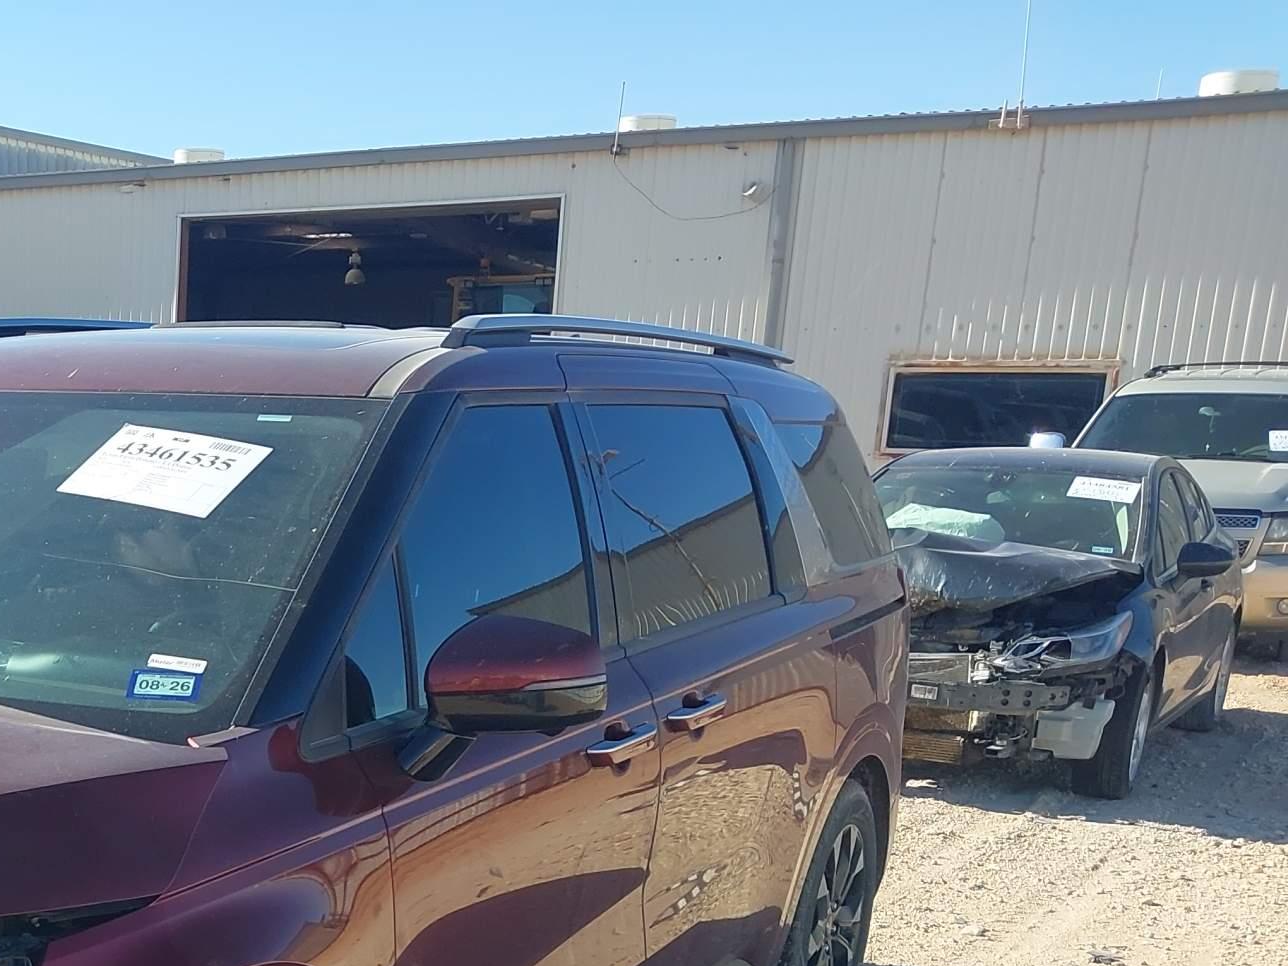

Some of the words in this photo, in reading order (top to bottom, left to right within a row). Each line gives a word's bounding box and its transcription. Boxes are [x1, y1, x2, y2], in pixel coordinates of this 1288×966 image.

[116, 441, 238, 472] 43461535
[139, 679, 160, 690] 08
[169, 680, 192, 692] 26
